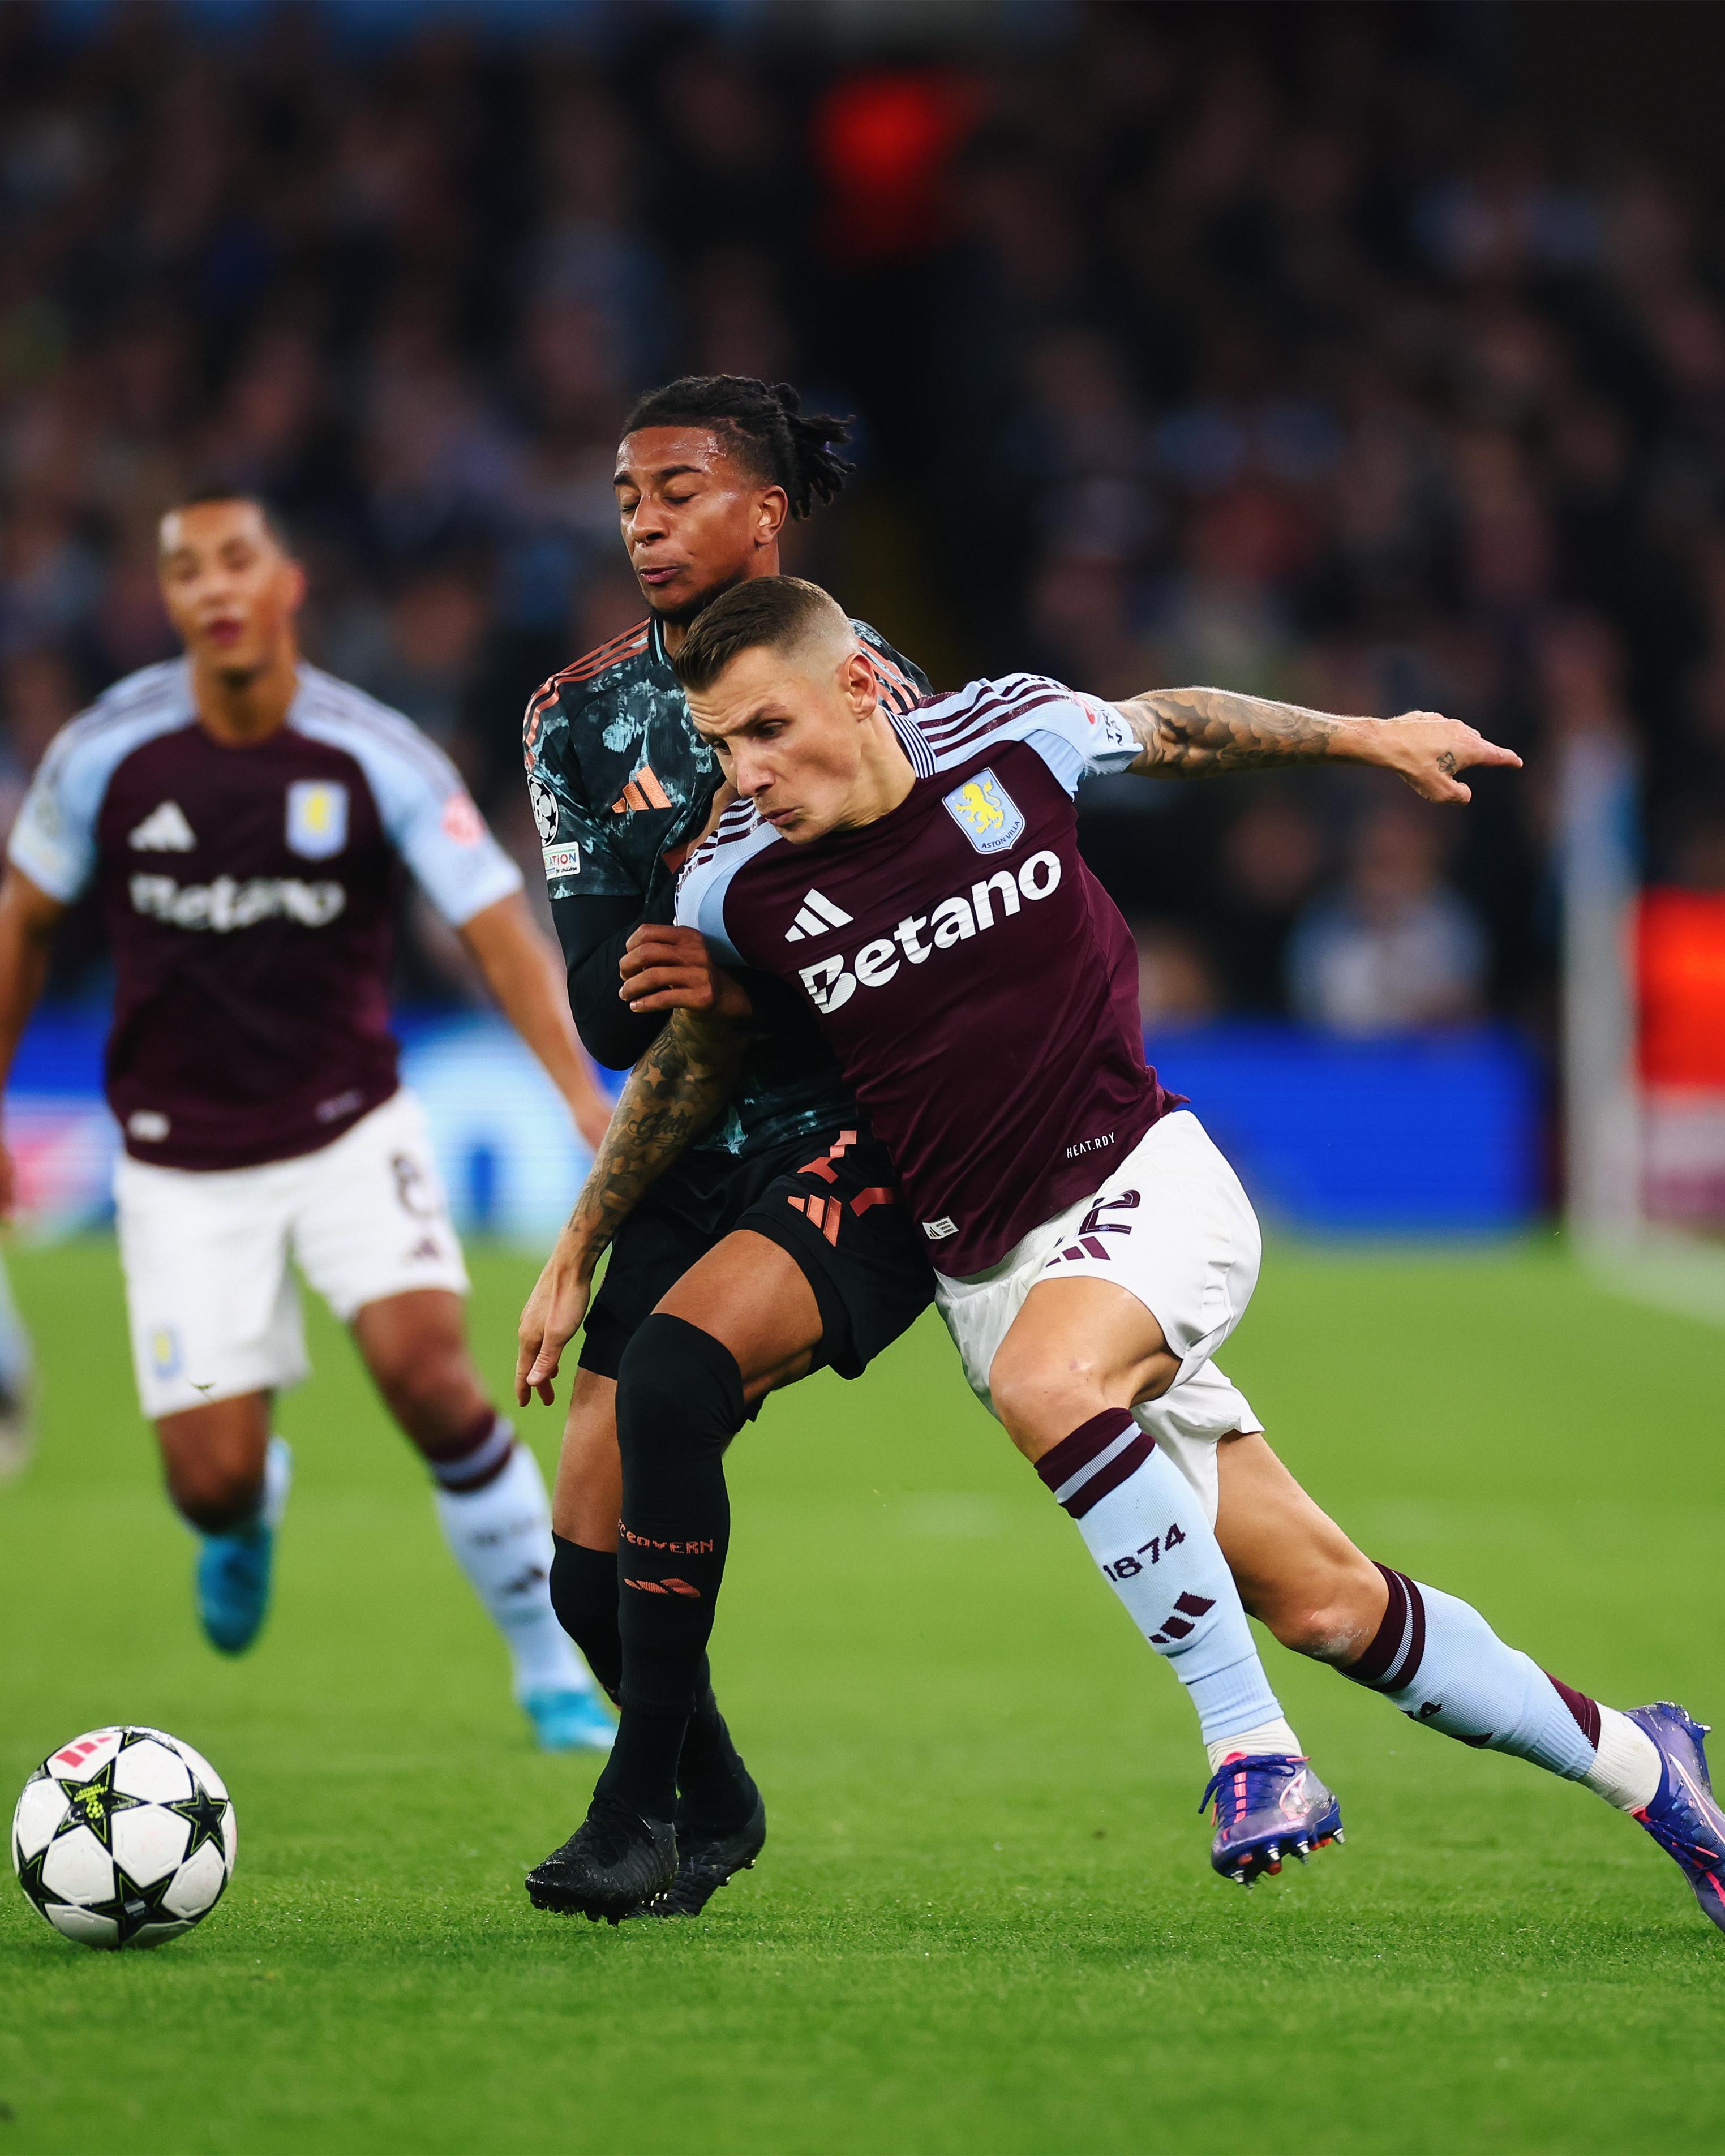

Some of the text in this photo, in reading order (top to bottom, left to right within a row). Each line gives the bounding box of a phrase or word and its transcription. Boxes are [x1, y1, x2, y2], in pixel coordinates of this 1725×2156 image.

[981, 838, 1006, 848] ASTON
[1005, 821, 1020, 839] VILLA
[799, 850, 1061, 1015] Betano
[1067, 1132, 1114, 1158] HEAT.RDY
[1103, 1523, 1186, 1582] 1874
